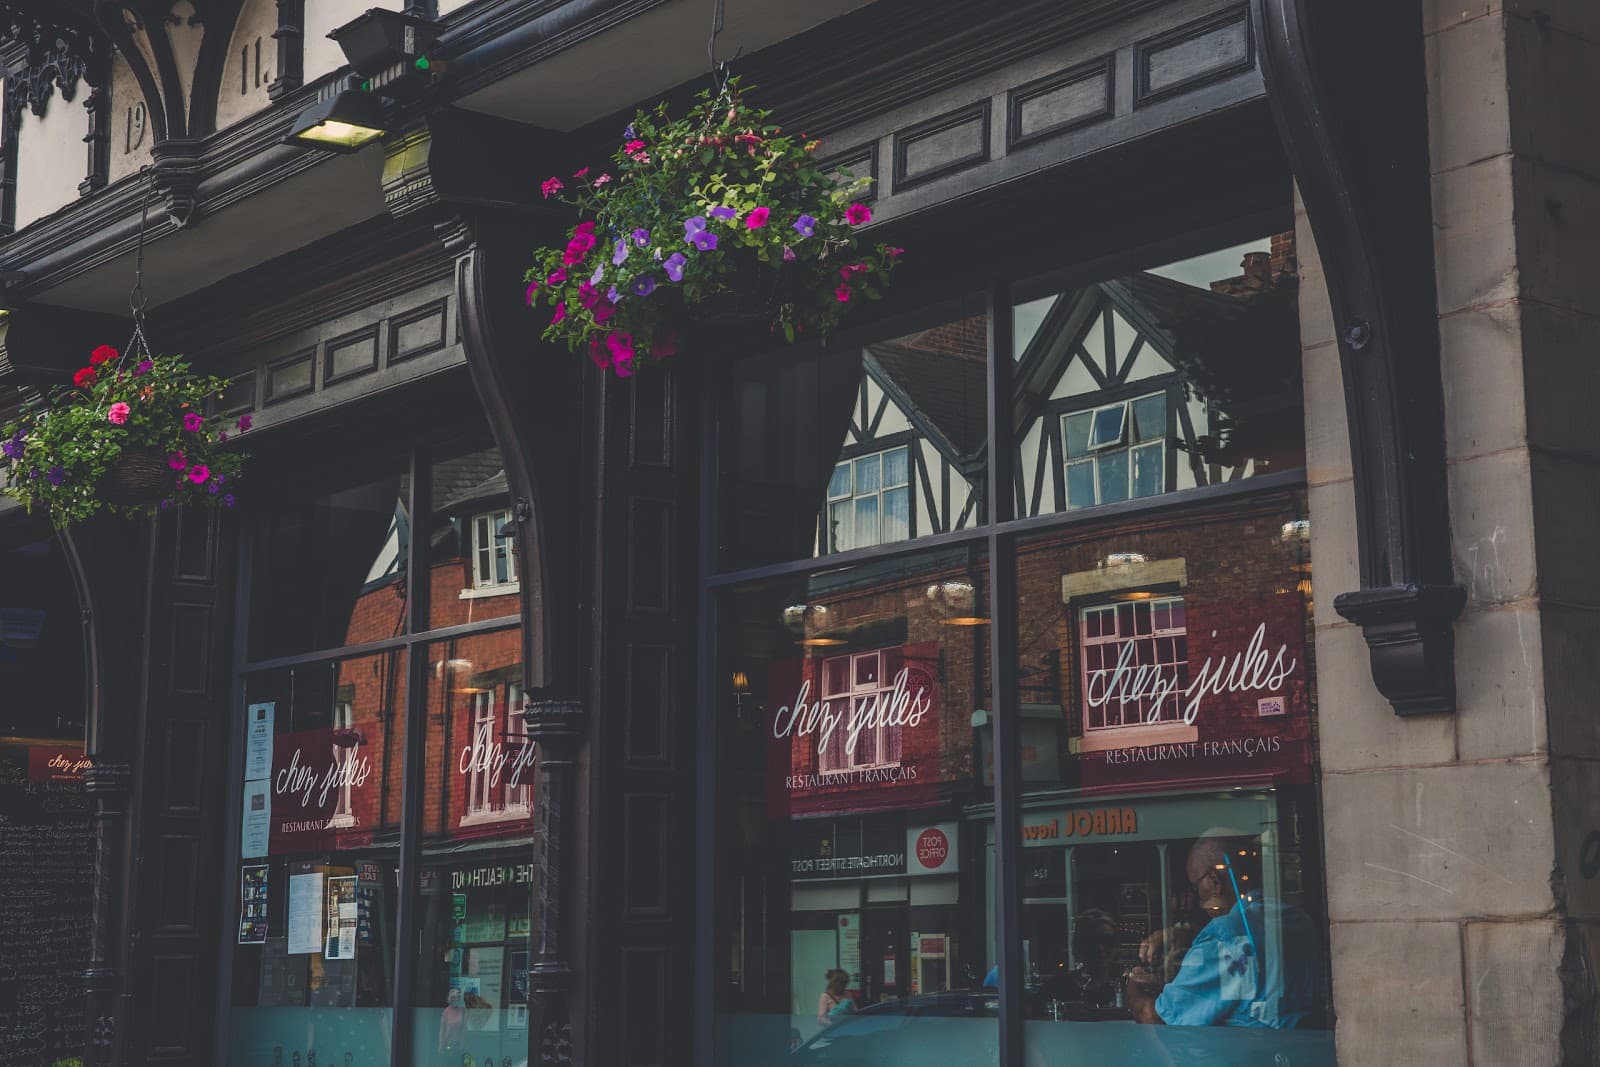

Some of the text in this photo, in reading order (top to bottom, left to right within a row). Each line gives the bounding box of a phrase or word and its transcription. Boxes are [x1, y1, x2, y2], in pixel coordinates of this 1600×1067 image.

[1088, 622, 1297, 725] chez jules
[773, 667, 932, 756] chez jules
[48, 754, 73, 773] chez
[459, 723, 510, 788] chez
[1106, 735, 1281, 765] RESTAURANT FRANÇAIS
[276, 748, 318, 808] chez
[319, 741, 371, 808] jules
[785, 765, 917, 789] RESTAURANT FRANÇAIS
[282, 820, 325, 833] RESTAURANT
